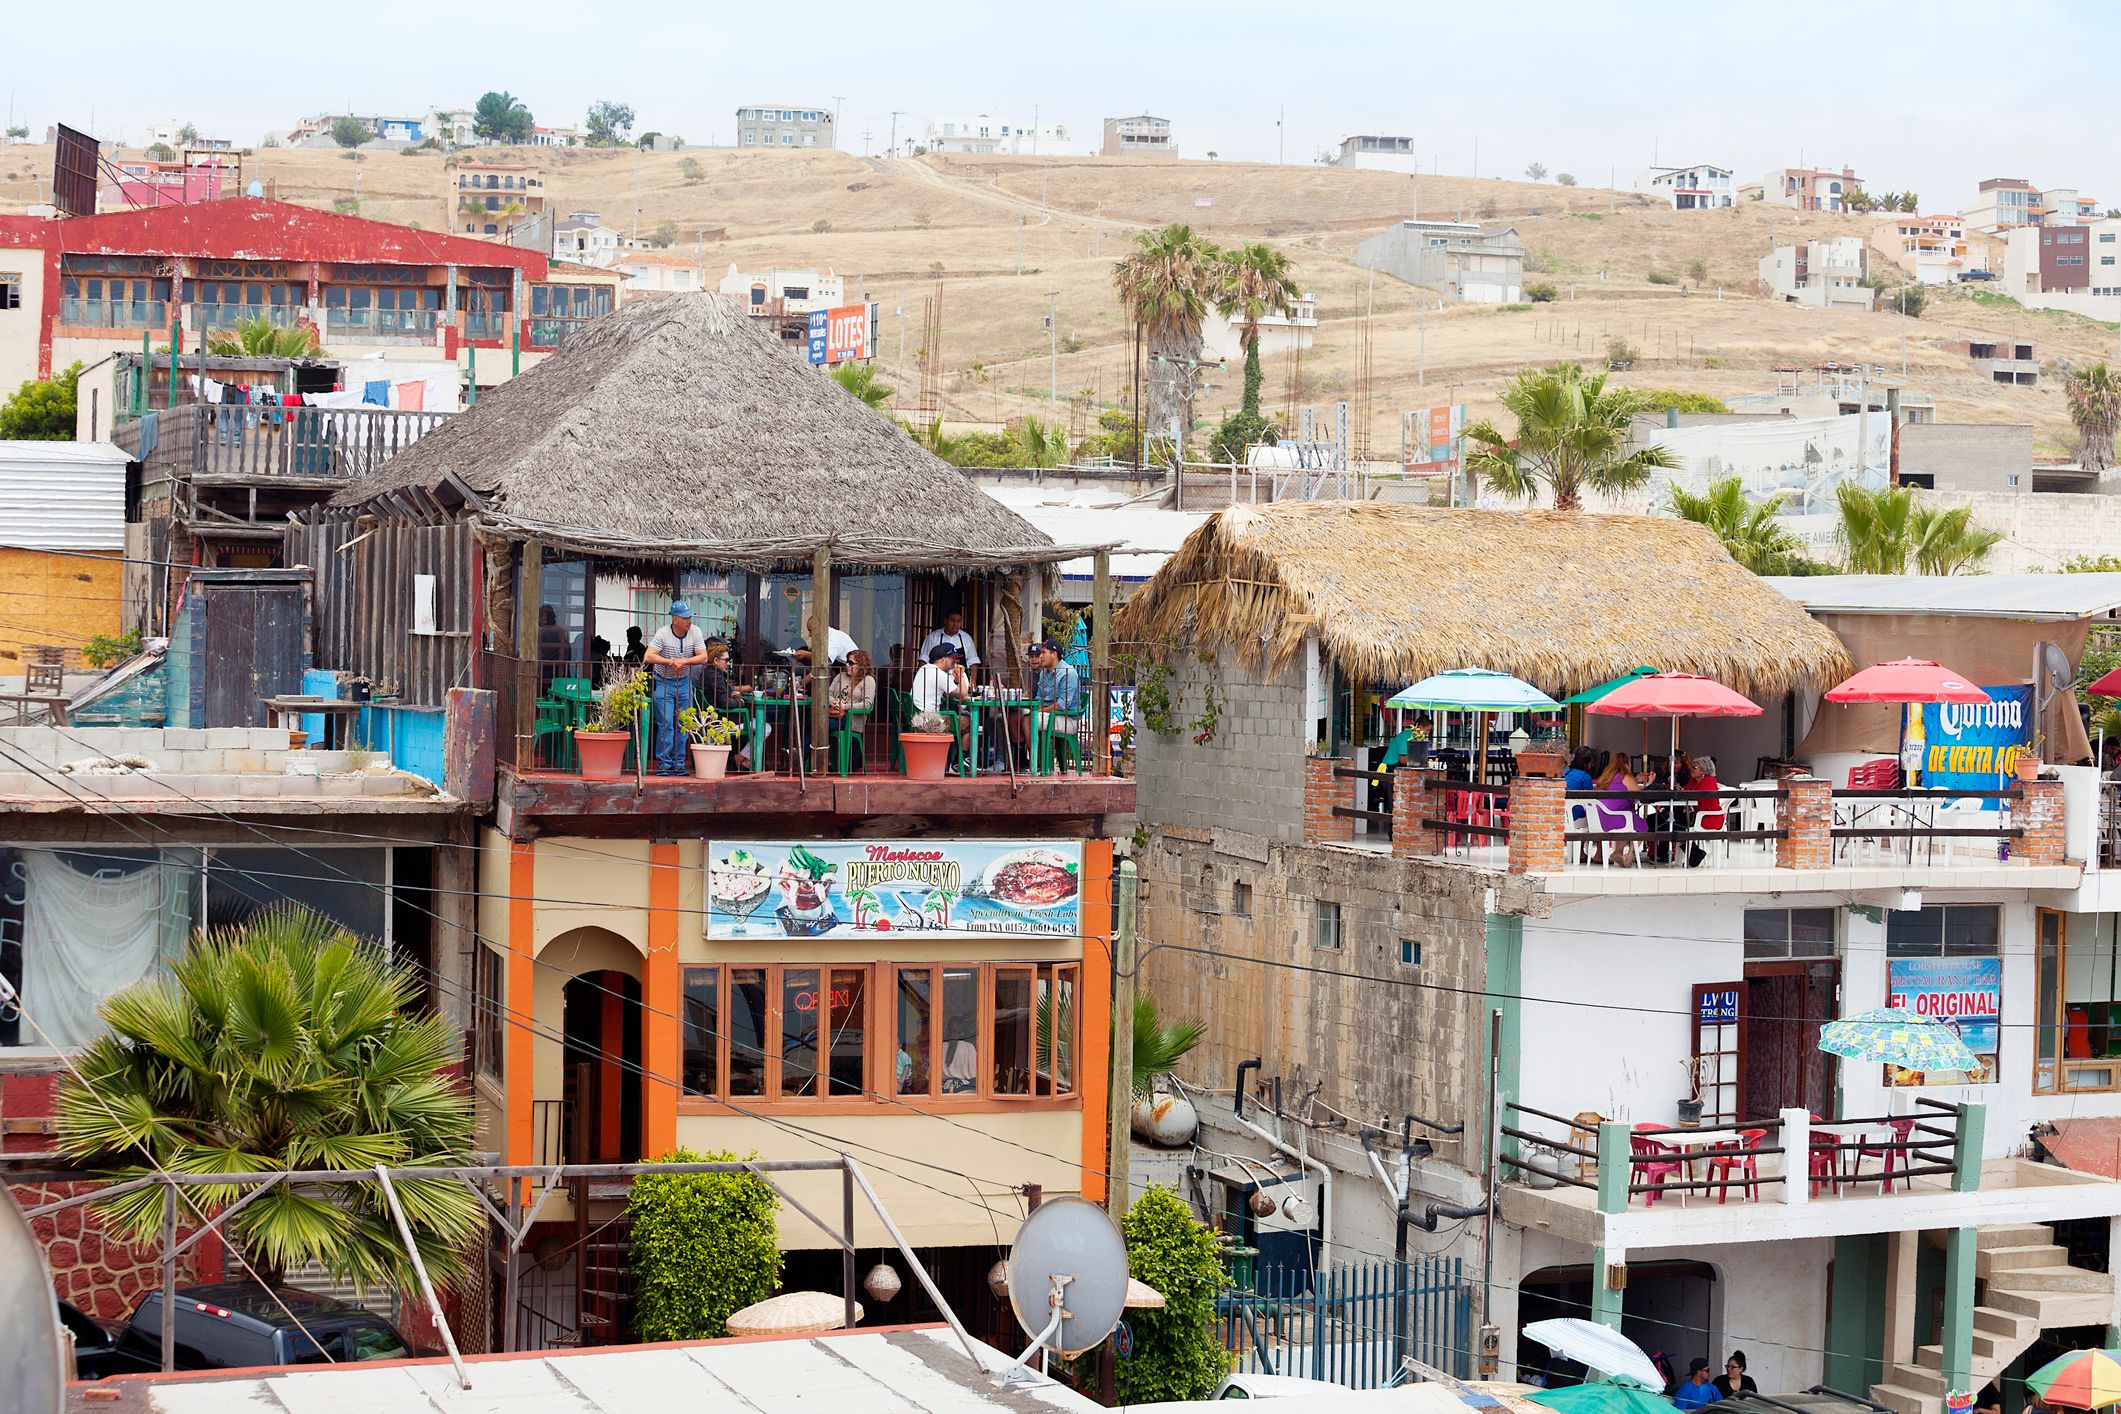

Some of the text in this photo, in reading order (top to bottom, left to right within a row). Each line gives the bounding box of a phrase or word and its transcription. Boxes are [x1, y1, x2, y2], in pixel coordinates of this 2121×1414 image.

[829, 315, 864, 350] LOTES
[1940, 700, 2022, 741] Corona
[1928, 745, 1949, 772] DE
[1949, 745, 1992, 774] VENTA
[865, 845, 943, 861] Mariscos
[847, 861, 960, 892] PUERTO NUEVO
[969, 908, 1012, 919] Speciality
[1014, 909, 1023, 917] in
[1029, 908, 1053, 918] Fresh
[966, 922, 986, 931] From
[989, 922, 1002, 932] USA
[1005, 923, 1028, 932] 01152
[1908, 961, 1982, 971] LOBSTER HOUSE
[1891, 973, 1997, 987] RESTAURANT BAR
[1916, 992, 1997, 1016] ORIGINAL
